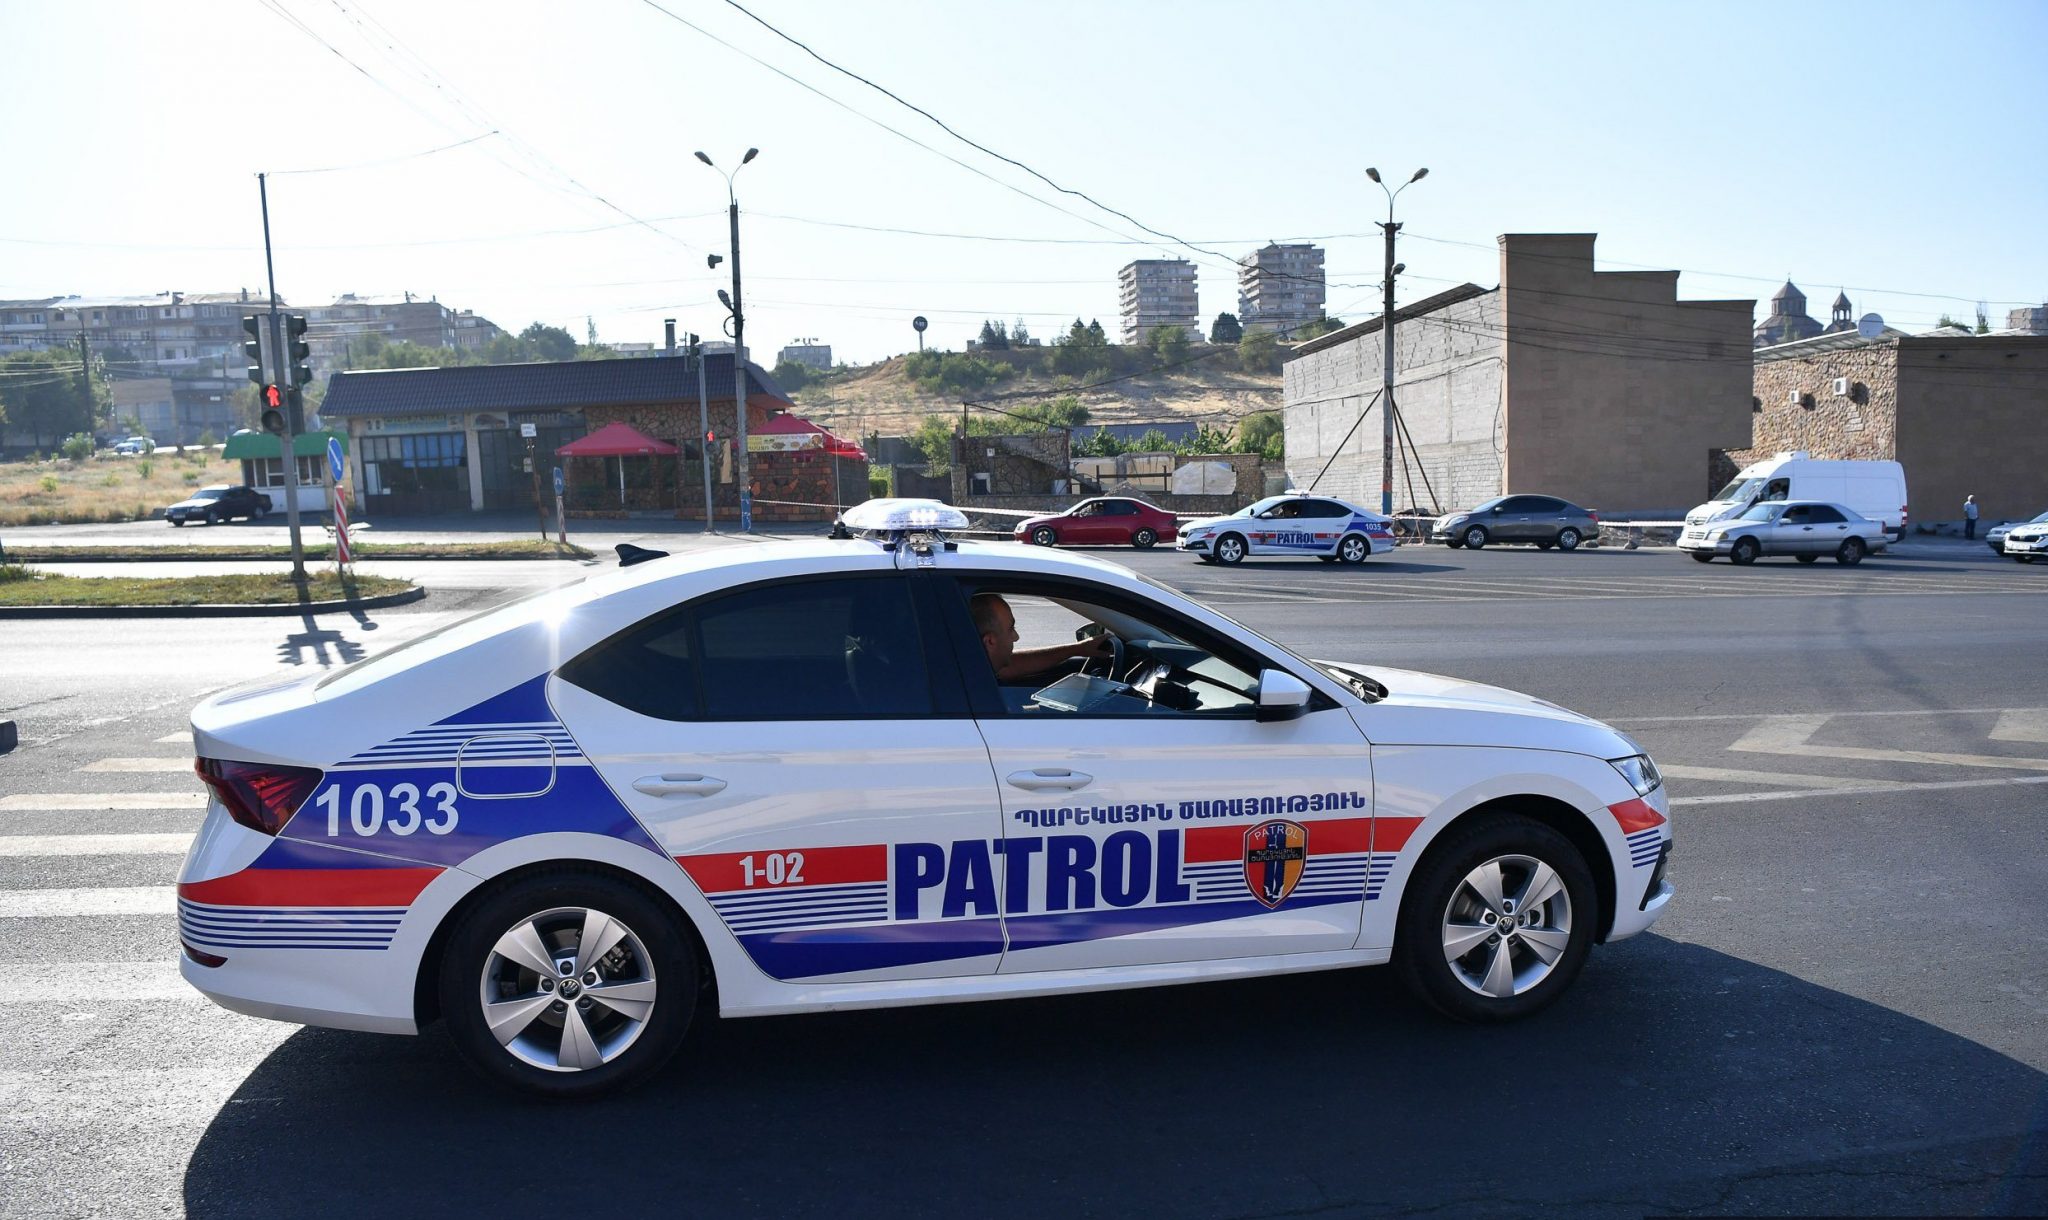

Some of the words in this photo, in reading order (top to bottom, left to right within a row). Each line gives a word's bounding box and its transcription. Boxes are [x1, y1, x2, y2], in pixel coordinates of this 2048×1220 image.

[1277, 532, 1316, 544] PATROL
[1365, 523, 1382, 531] 1035
[316, 782, 459, 837] 1033
[1014, 803, 1173, 828] ՊԱՐԵԿԱՅԻՆ
[1178, 791, 1366, 820] ԾԱՌԱՅՈՒԹՅՈՒՆ
[1254, 825, 1298, 840] PATROL
[739, 852, 804, 886] 1-02
[894, 828, 1191, 921] PATROL
